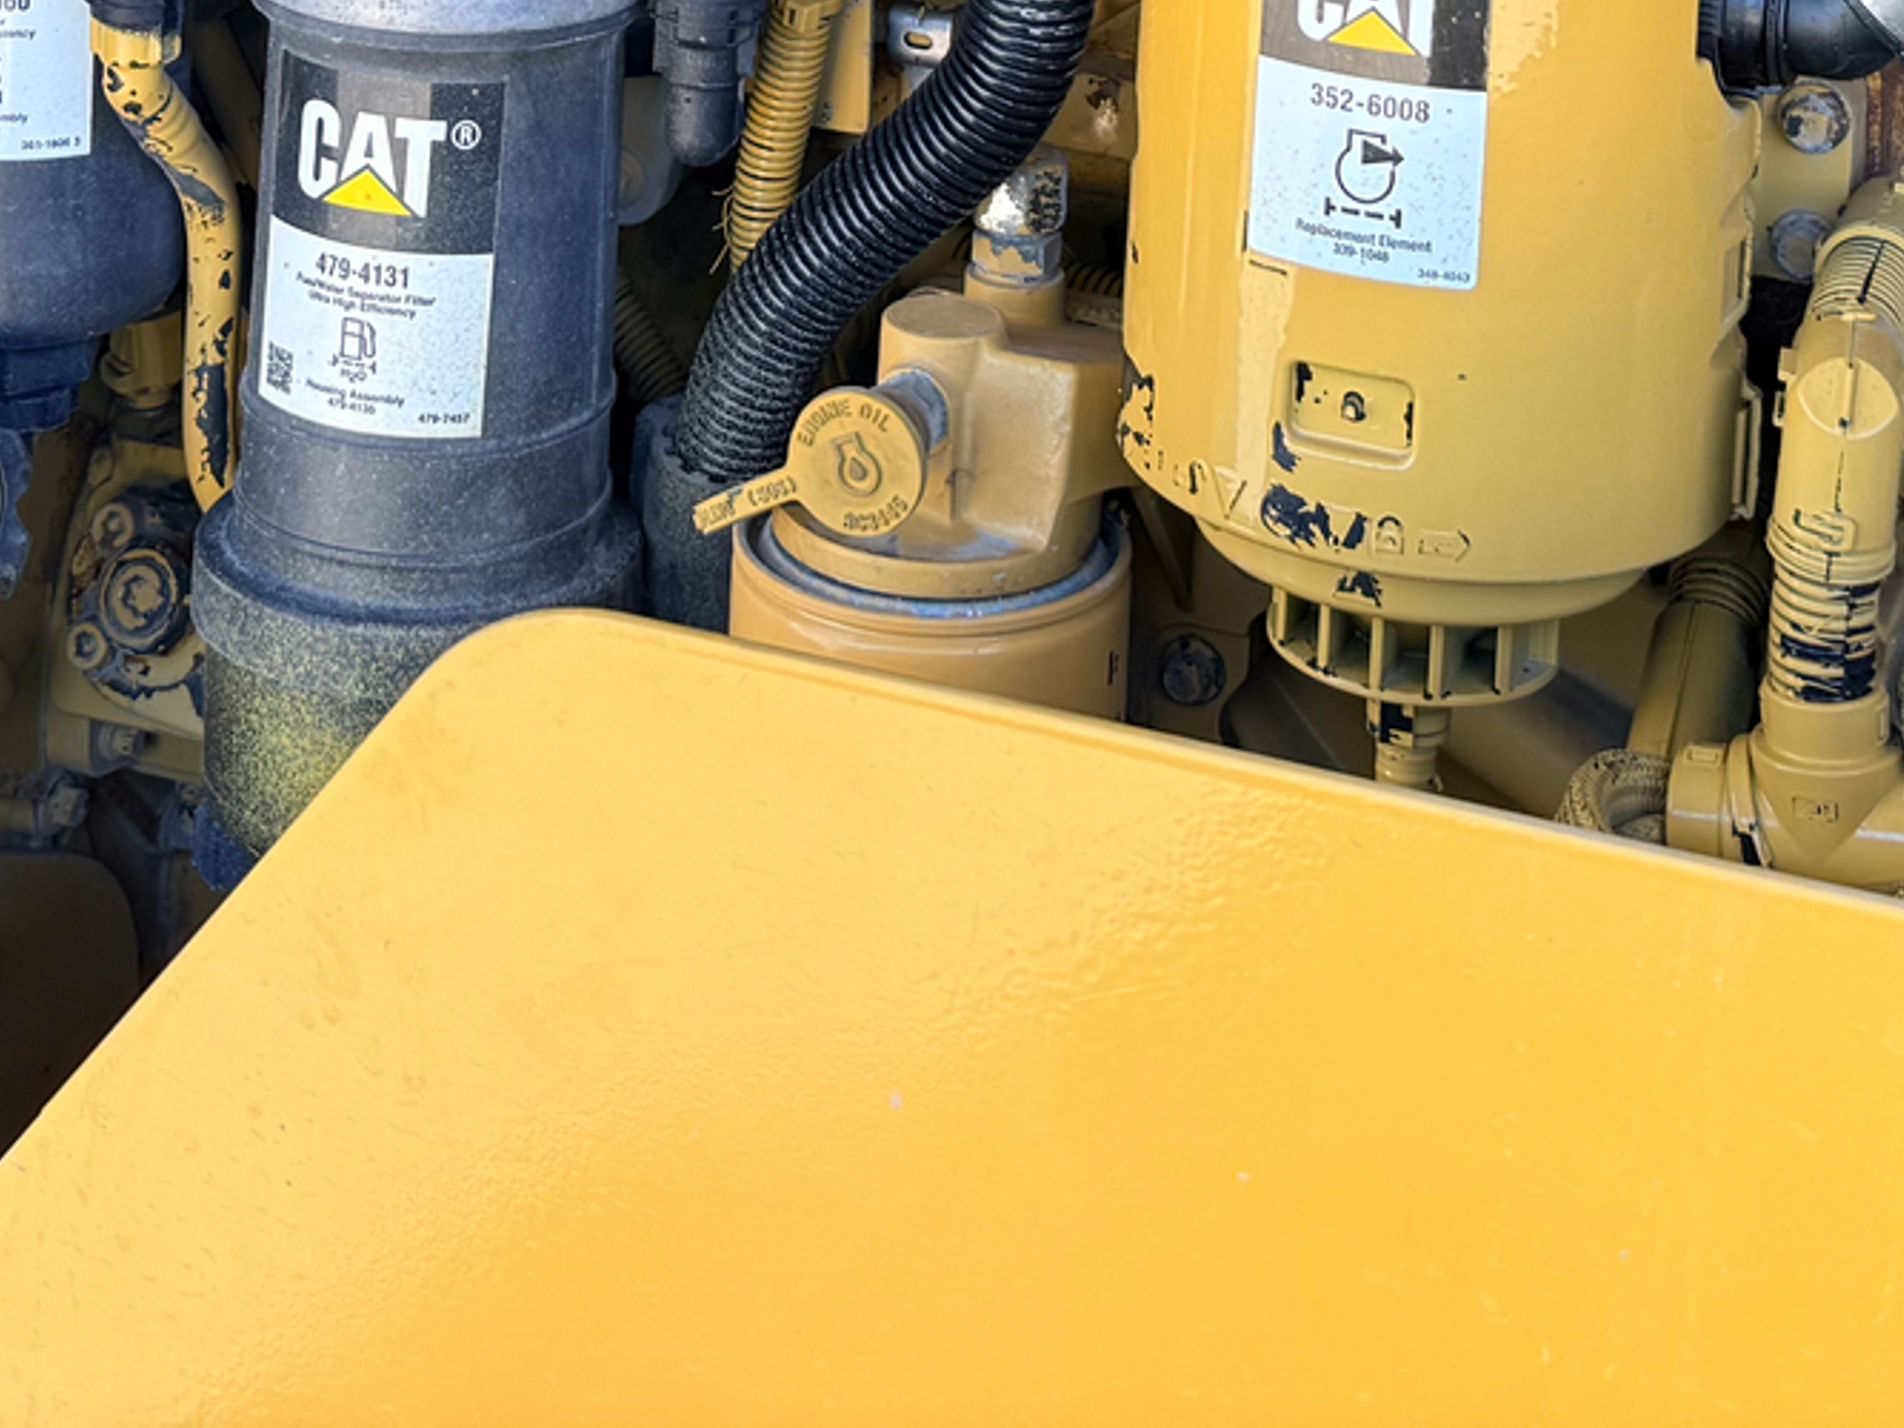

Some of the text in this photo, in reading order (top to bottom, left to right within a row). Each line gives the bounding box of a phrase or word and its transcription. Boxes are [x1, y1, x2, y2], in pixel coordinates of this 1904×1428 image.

[1310, 82, 1431, 124] 352-6008
[1295, 217, 1433, 254] Replacement Element
[315, 251, 410, 290] 479-4131
[331, 295, 358, 313] High
[403, 294, 437, 308] Filter
[350, 388, 406, 408] Assembly
[797, 399, 892, 448] ENGINE OIL
